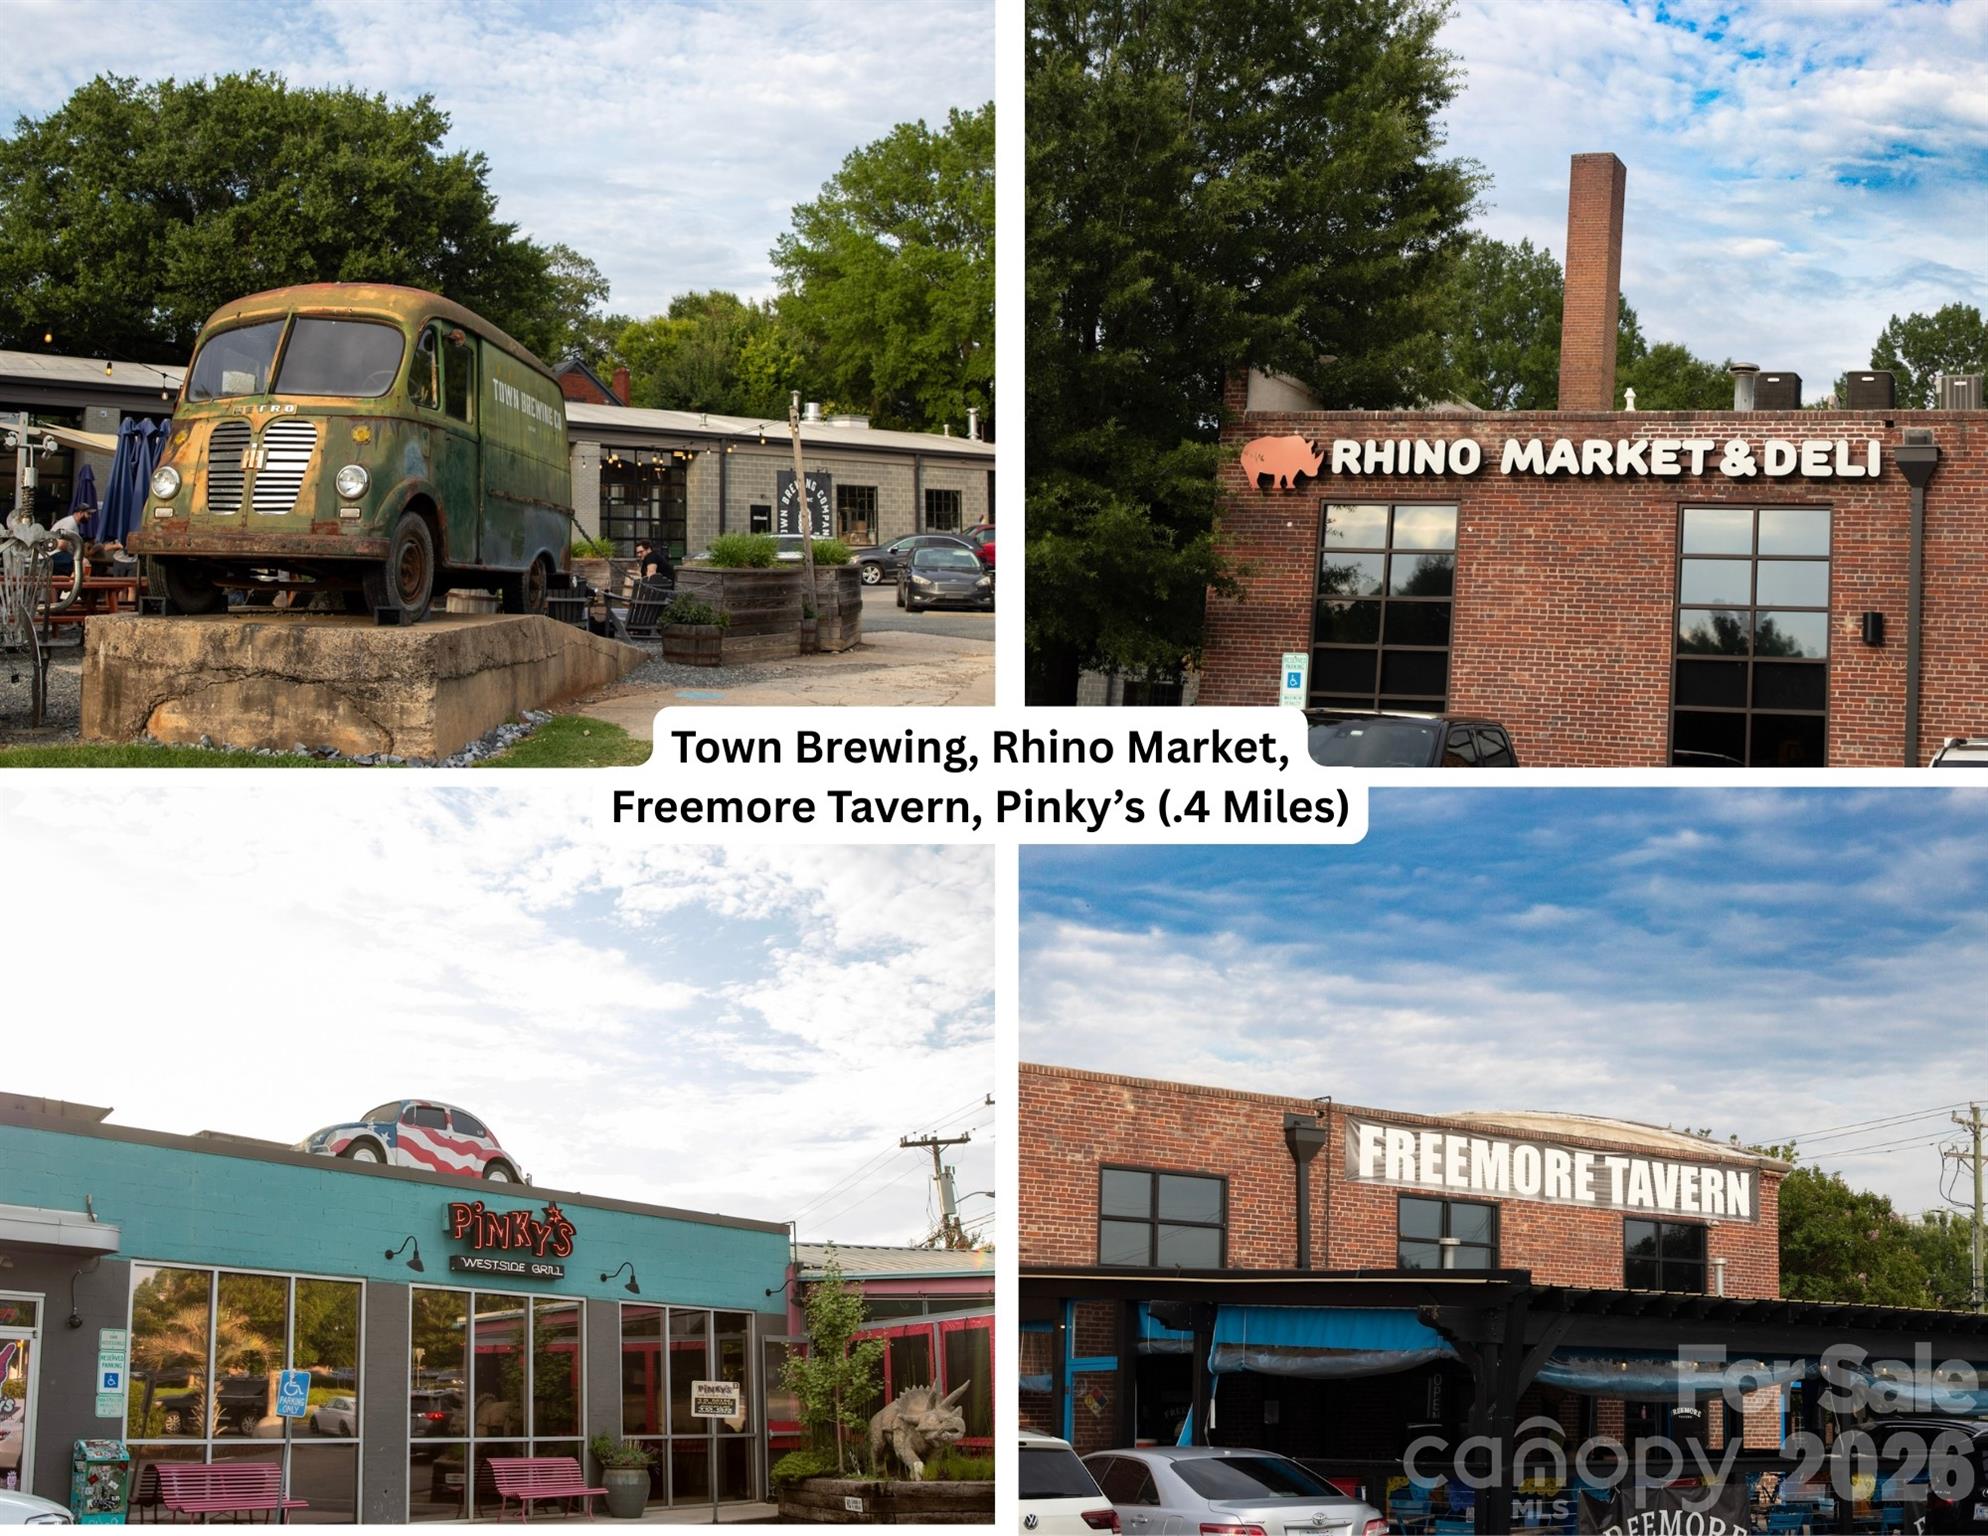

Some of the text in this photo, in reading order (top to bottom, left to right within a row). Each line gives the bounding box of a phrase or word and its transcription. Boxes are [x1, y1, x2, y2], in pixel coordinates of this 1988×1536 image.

[493, 377, 519, 410] TOWN
[520, 391, 553, 427] BREWING
[1331, 439, 1482, 475] RHINO
[782, 478, 817, 505] BRENG
[816, 489, 831, 536] COMPAN
[1359, 1124, 1751, 1217] FREEMORE TAVERN
[460, 1256, 564, 1276] WESTSIDE GRILL
[279, 1395, 306, 1407] PARKING
[281, 1405, 300, 1415] ONLY
